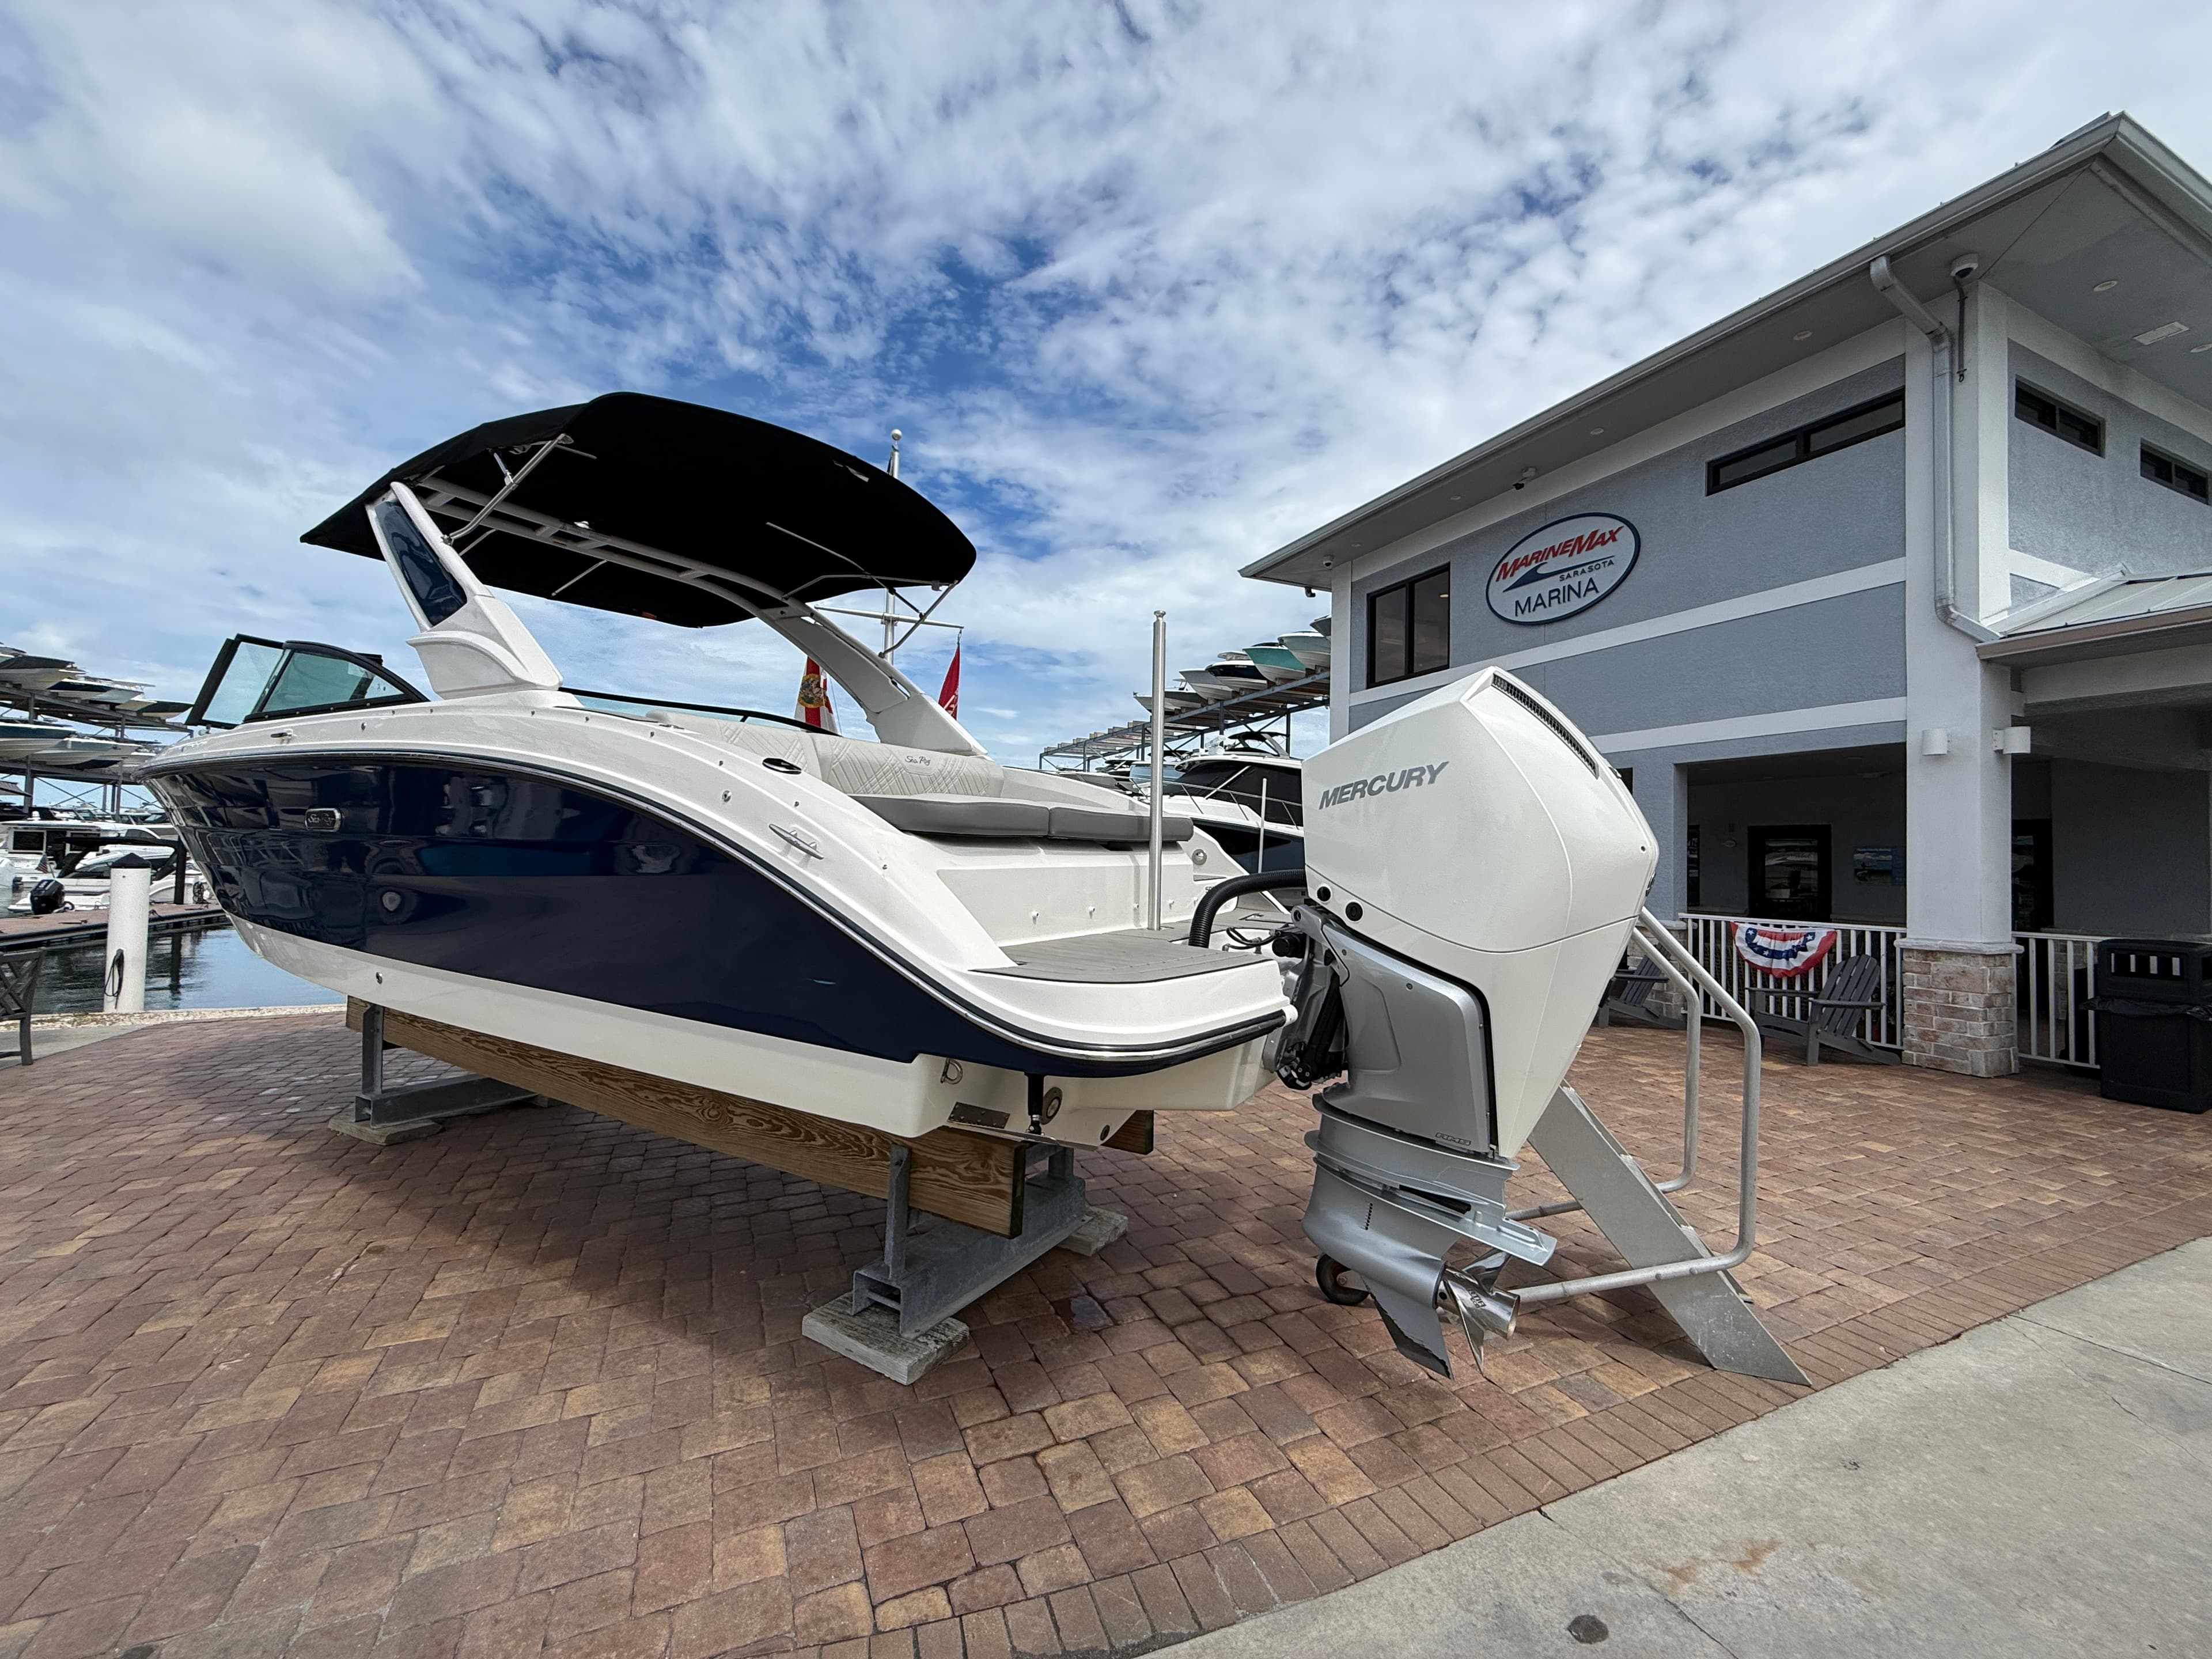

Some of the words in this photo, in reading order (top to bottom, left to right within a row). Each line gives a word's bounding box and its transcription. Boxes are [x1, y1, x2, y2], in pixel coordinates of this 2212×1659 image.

[1559, 559, 1615, 582] SARASOTA
[1514, 577, 1600, 617] MARINA
[1319, 760, 1449, 810] MERCURY
